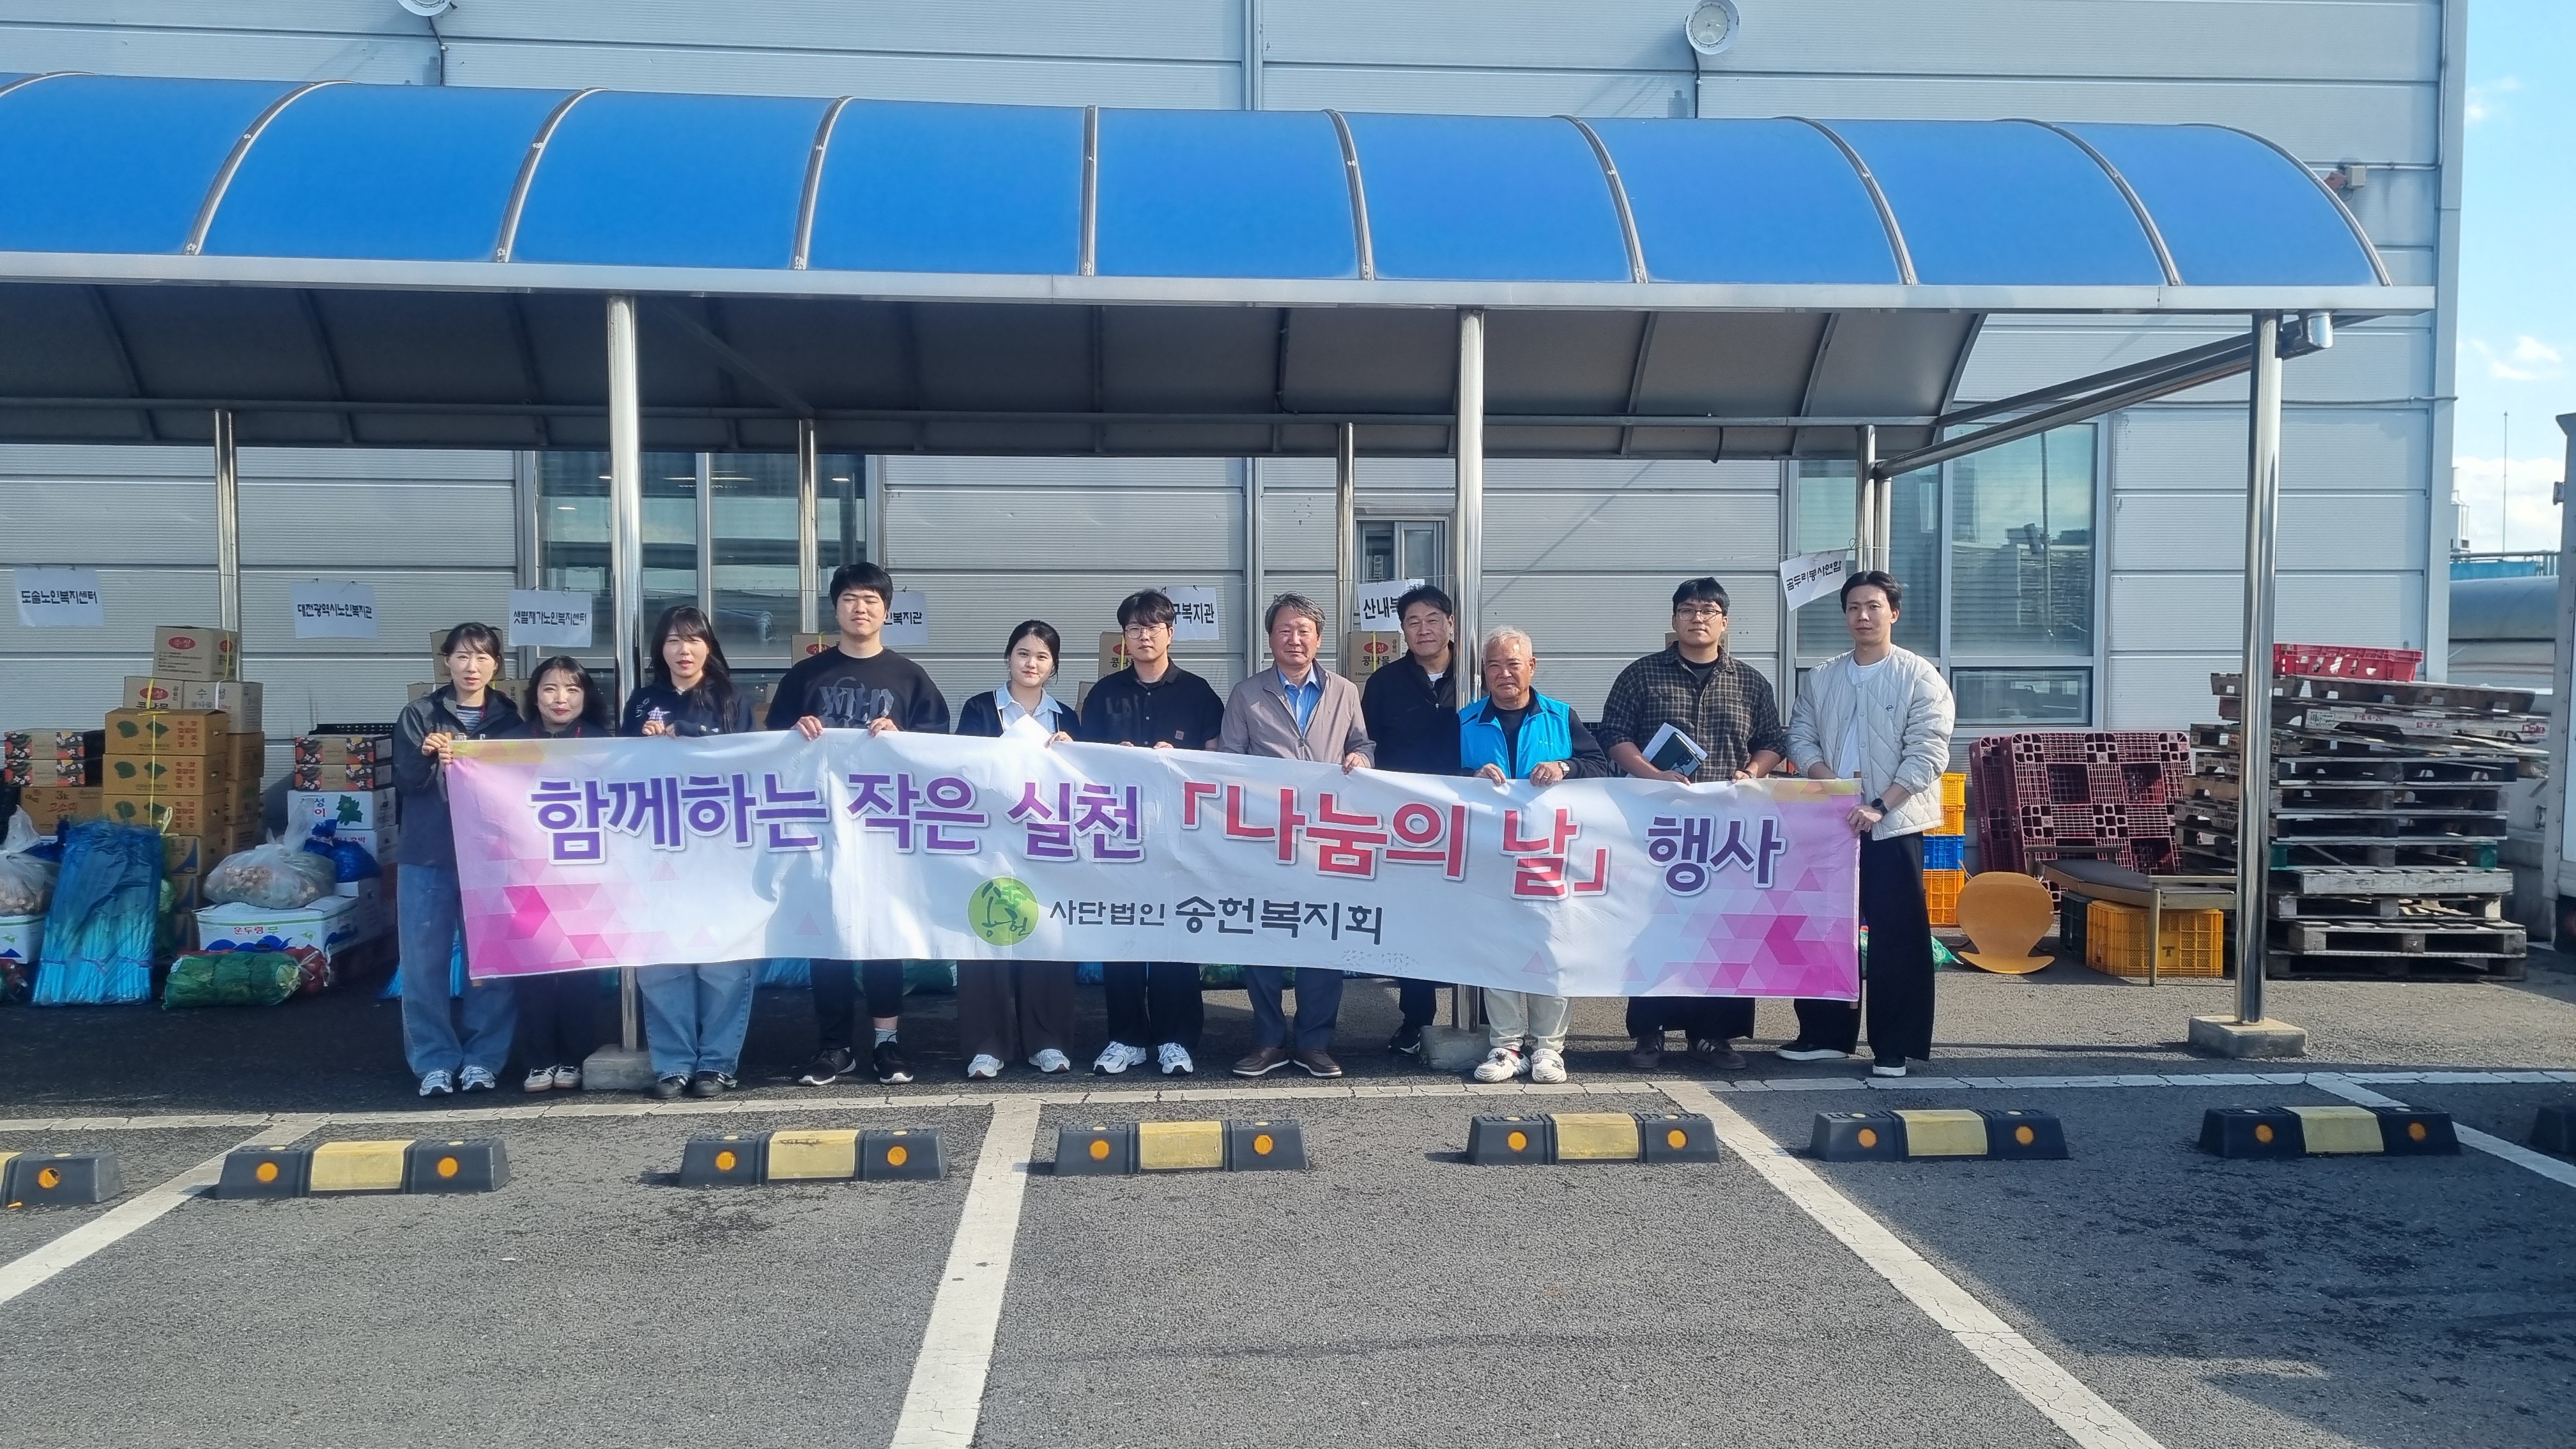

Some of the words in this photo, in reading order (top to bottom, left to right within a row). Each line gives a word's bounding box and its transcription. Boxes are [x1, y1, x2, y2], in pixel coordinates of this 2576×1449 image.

[1786, 560, 1842, 591] 곰두리봉사연합
[21, 590, 98, 604] 도솔노인복지센터
[297, 603, 372, 619] 대전광역시노인복지관
[513, 611, 587, 625] 샛별재가노인복지센터
[530, 772, 828, 861] 함께하는
[846, 773, 985, 850] 작은
[1007, 781, 1144, 859] 실천
[1647, 816, 1783, 893] 행사
[1050, 900, 1166, 926] 사단법인
[1175, 896, 1383, 945] 송헌복지회
